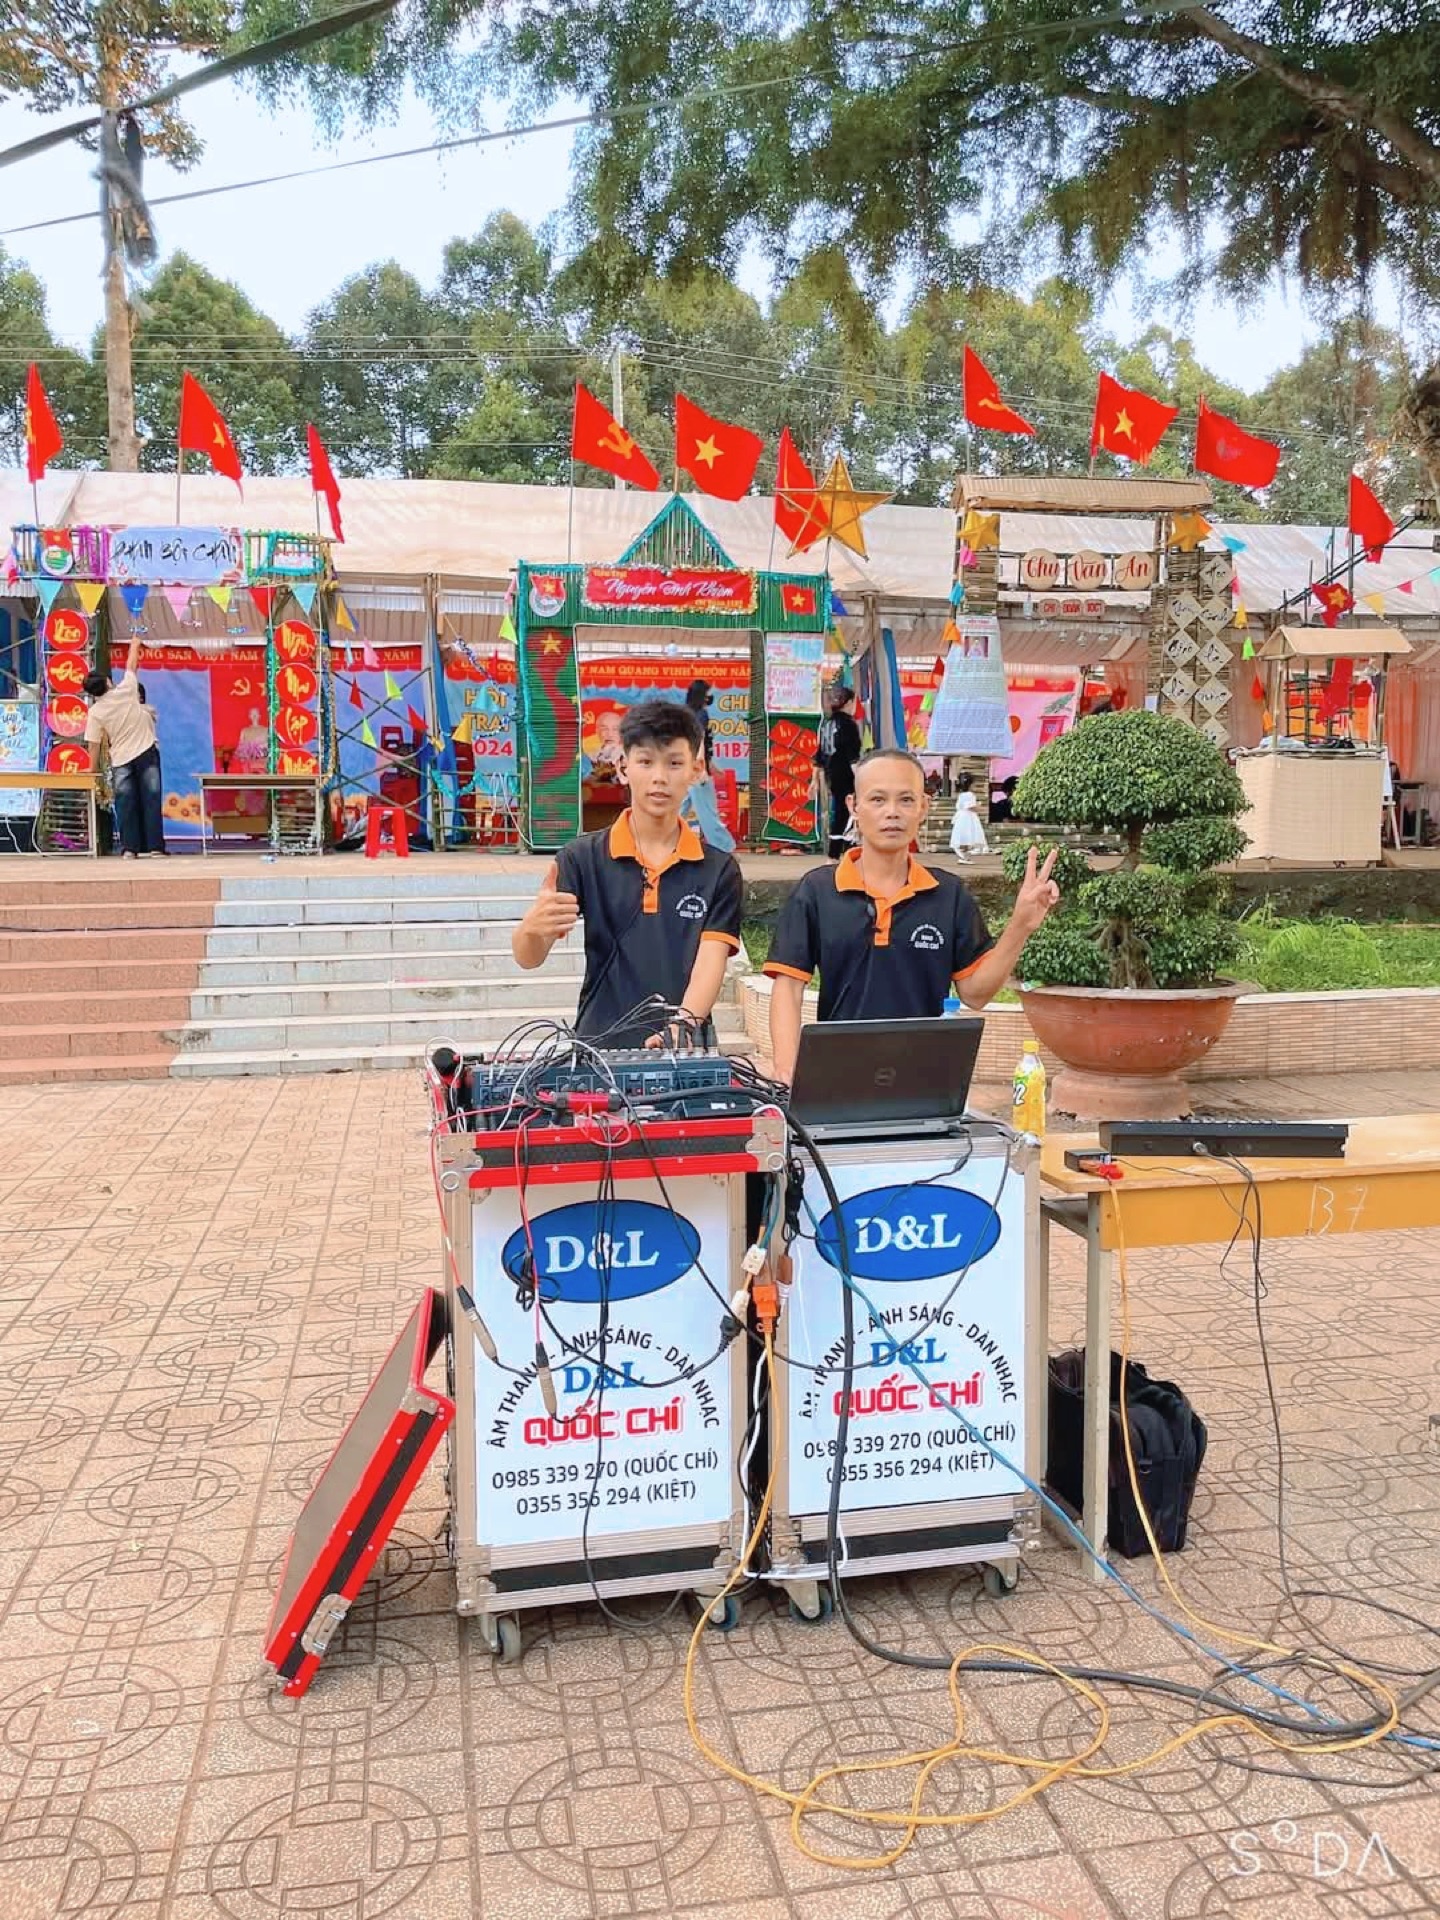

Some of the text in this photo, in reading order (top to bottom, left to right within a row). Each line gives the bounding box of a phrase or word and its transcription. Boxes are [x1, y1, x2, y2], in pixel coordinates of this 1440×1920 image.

[1027, 555, 1059, 578] Chu
[1115, 556, 1148, 582] An
[618, 666, 659, 676] QUANG
[544, 1230, 660, 1274] D&L
[855, 1212, 962, 1254] D&L
[870, 1337, 948, 1368] D&L
[908, 1303, 955, 1327] SÁNG
[991, 1355, 1018, 1403] NHẠC
[487, 1419, 509, 1449] ÂM
[604, 1324, 653, 1349] SÁNG
[691, 1379, 720, 1429] NHẠC
[833, 1371, 981, 1417] QUỐC CHÍ
[524, 1396, 681, 1446] QUỐC CHÍ
[853, 1435, 885, 1454] 339
[889, 1432, 921, 1451] 270
[983, 1420, 1016, 1443] CHÍ)
[491, 1447, 719, 1489] 0985 339 270 (QUỐC CHÍ)
[873, 1460, 905, 1479] 356
[910, 1456, 943, 1476] 294
[948, 1450, 994, 1473] (KIỆT)
[516, 1480, 696, 1516] 0355 356 294 (KIỆT)
